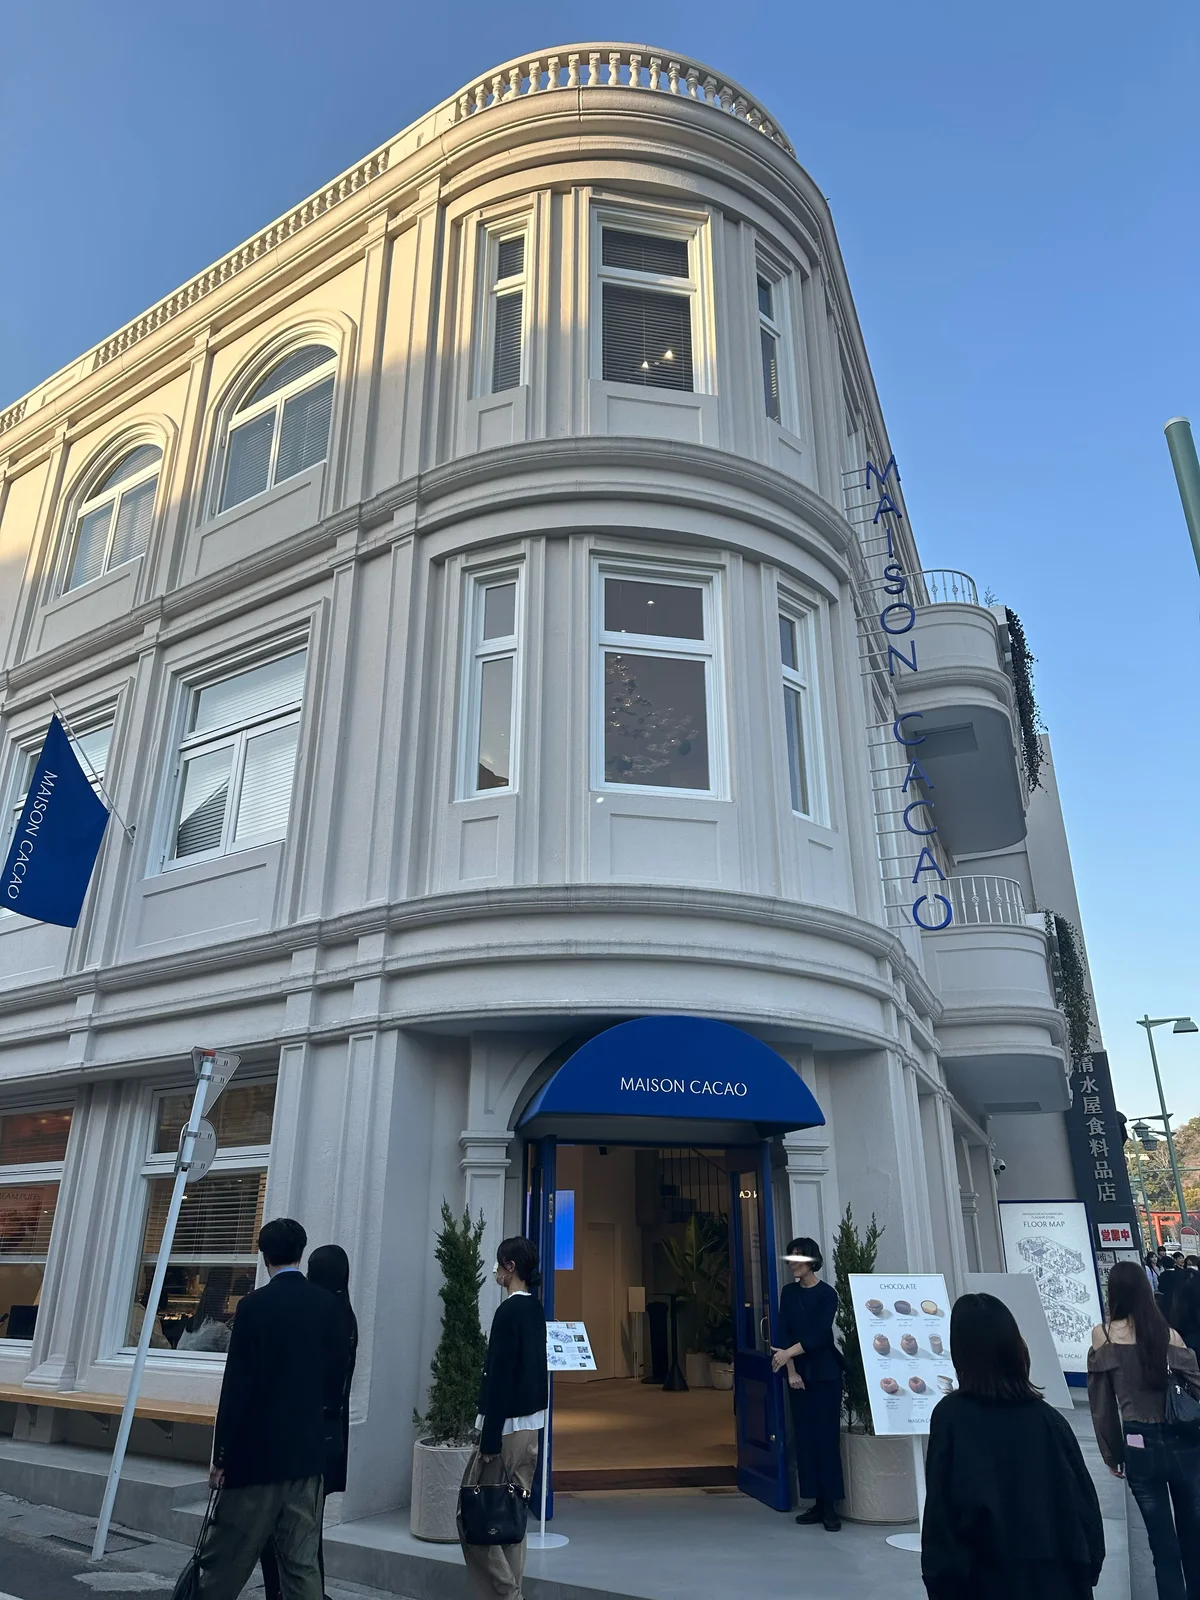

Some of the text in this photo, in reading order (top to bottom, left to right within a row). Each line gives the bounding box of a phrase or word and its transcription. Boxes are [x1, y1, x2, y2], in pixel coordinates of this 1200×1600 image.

[865, 454, 953, 931] MAISON CACAO
[7, 770, 58, 900] MAISON CACAO
[620, 1076, 748, 1097] MAISON CACAO
